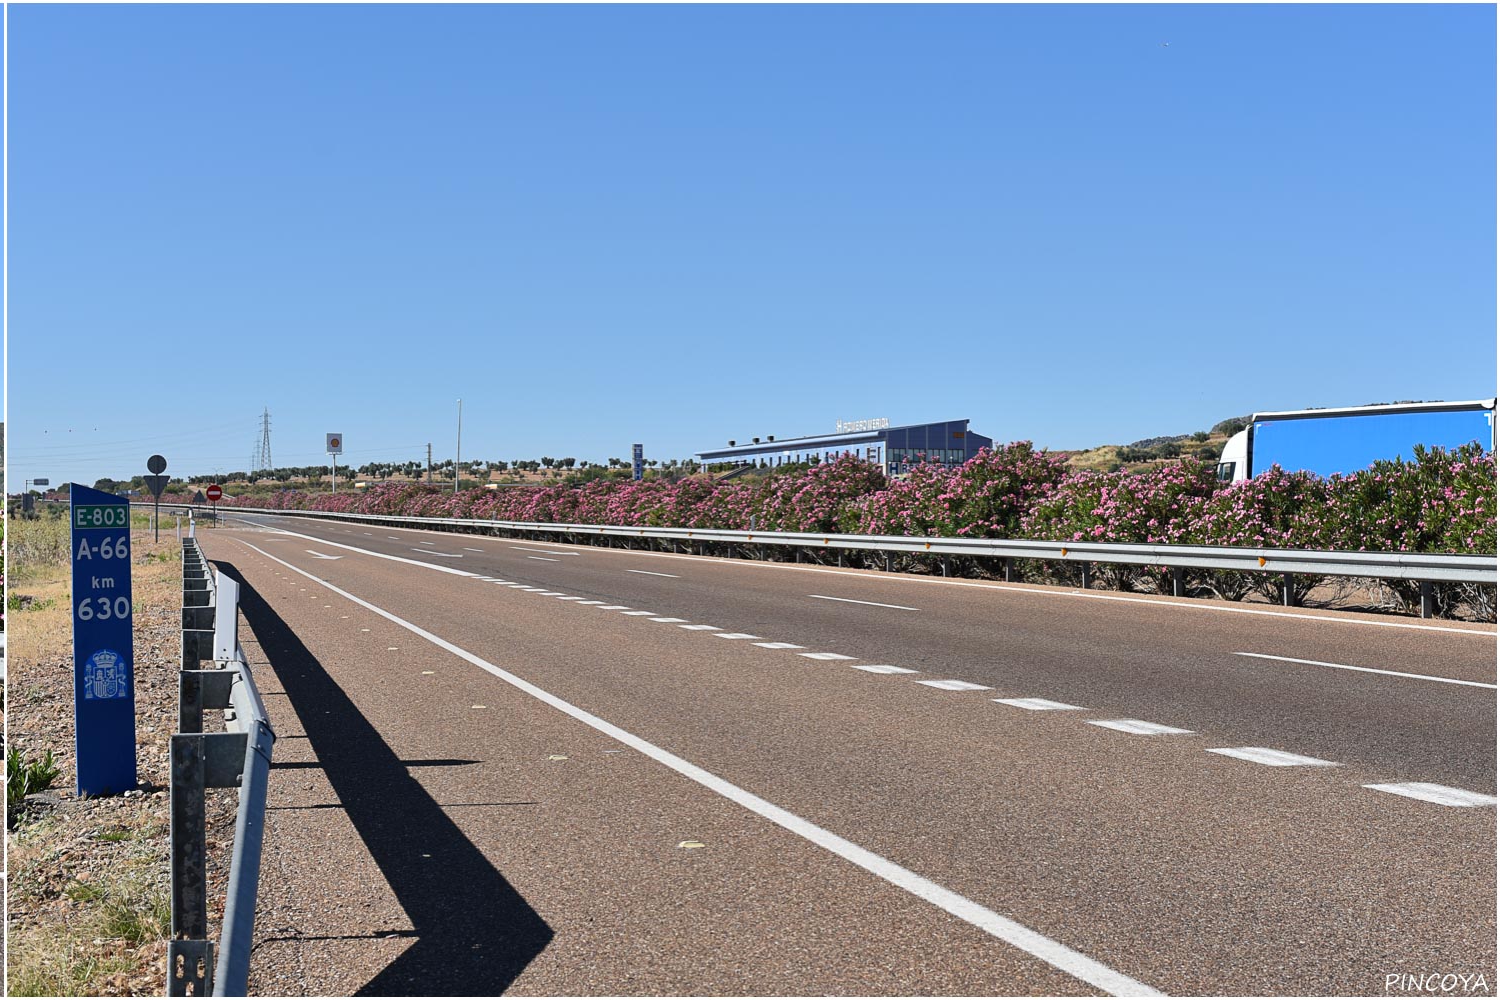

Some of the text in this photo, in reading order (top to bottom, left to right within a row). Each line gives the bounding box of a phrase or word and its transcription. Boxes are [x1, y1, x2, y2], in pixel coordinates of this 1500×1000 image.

[76, 508, 127, 527] E-803
[76, 536, 129, 561] A-66
[91, 575, 115, 589] km
[77, 597, 130, 621] 630
